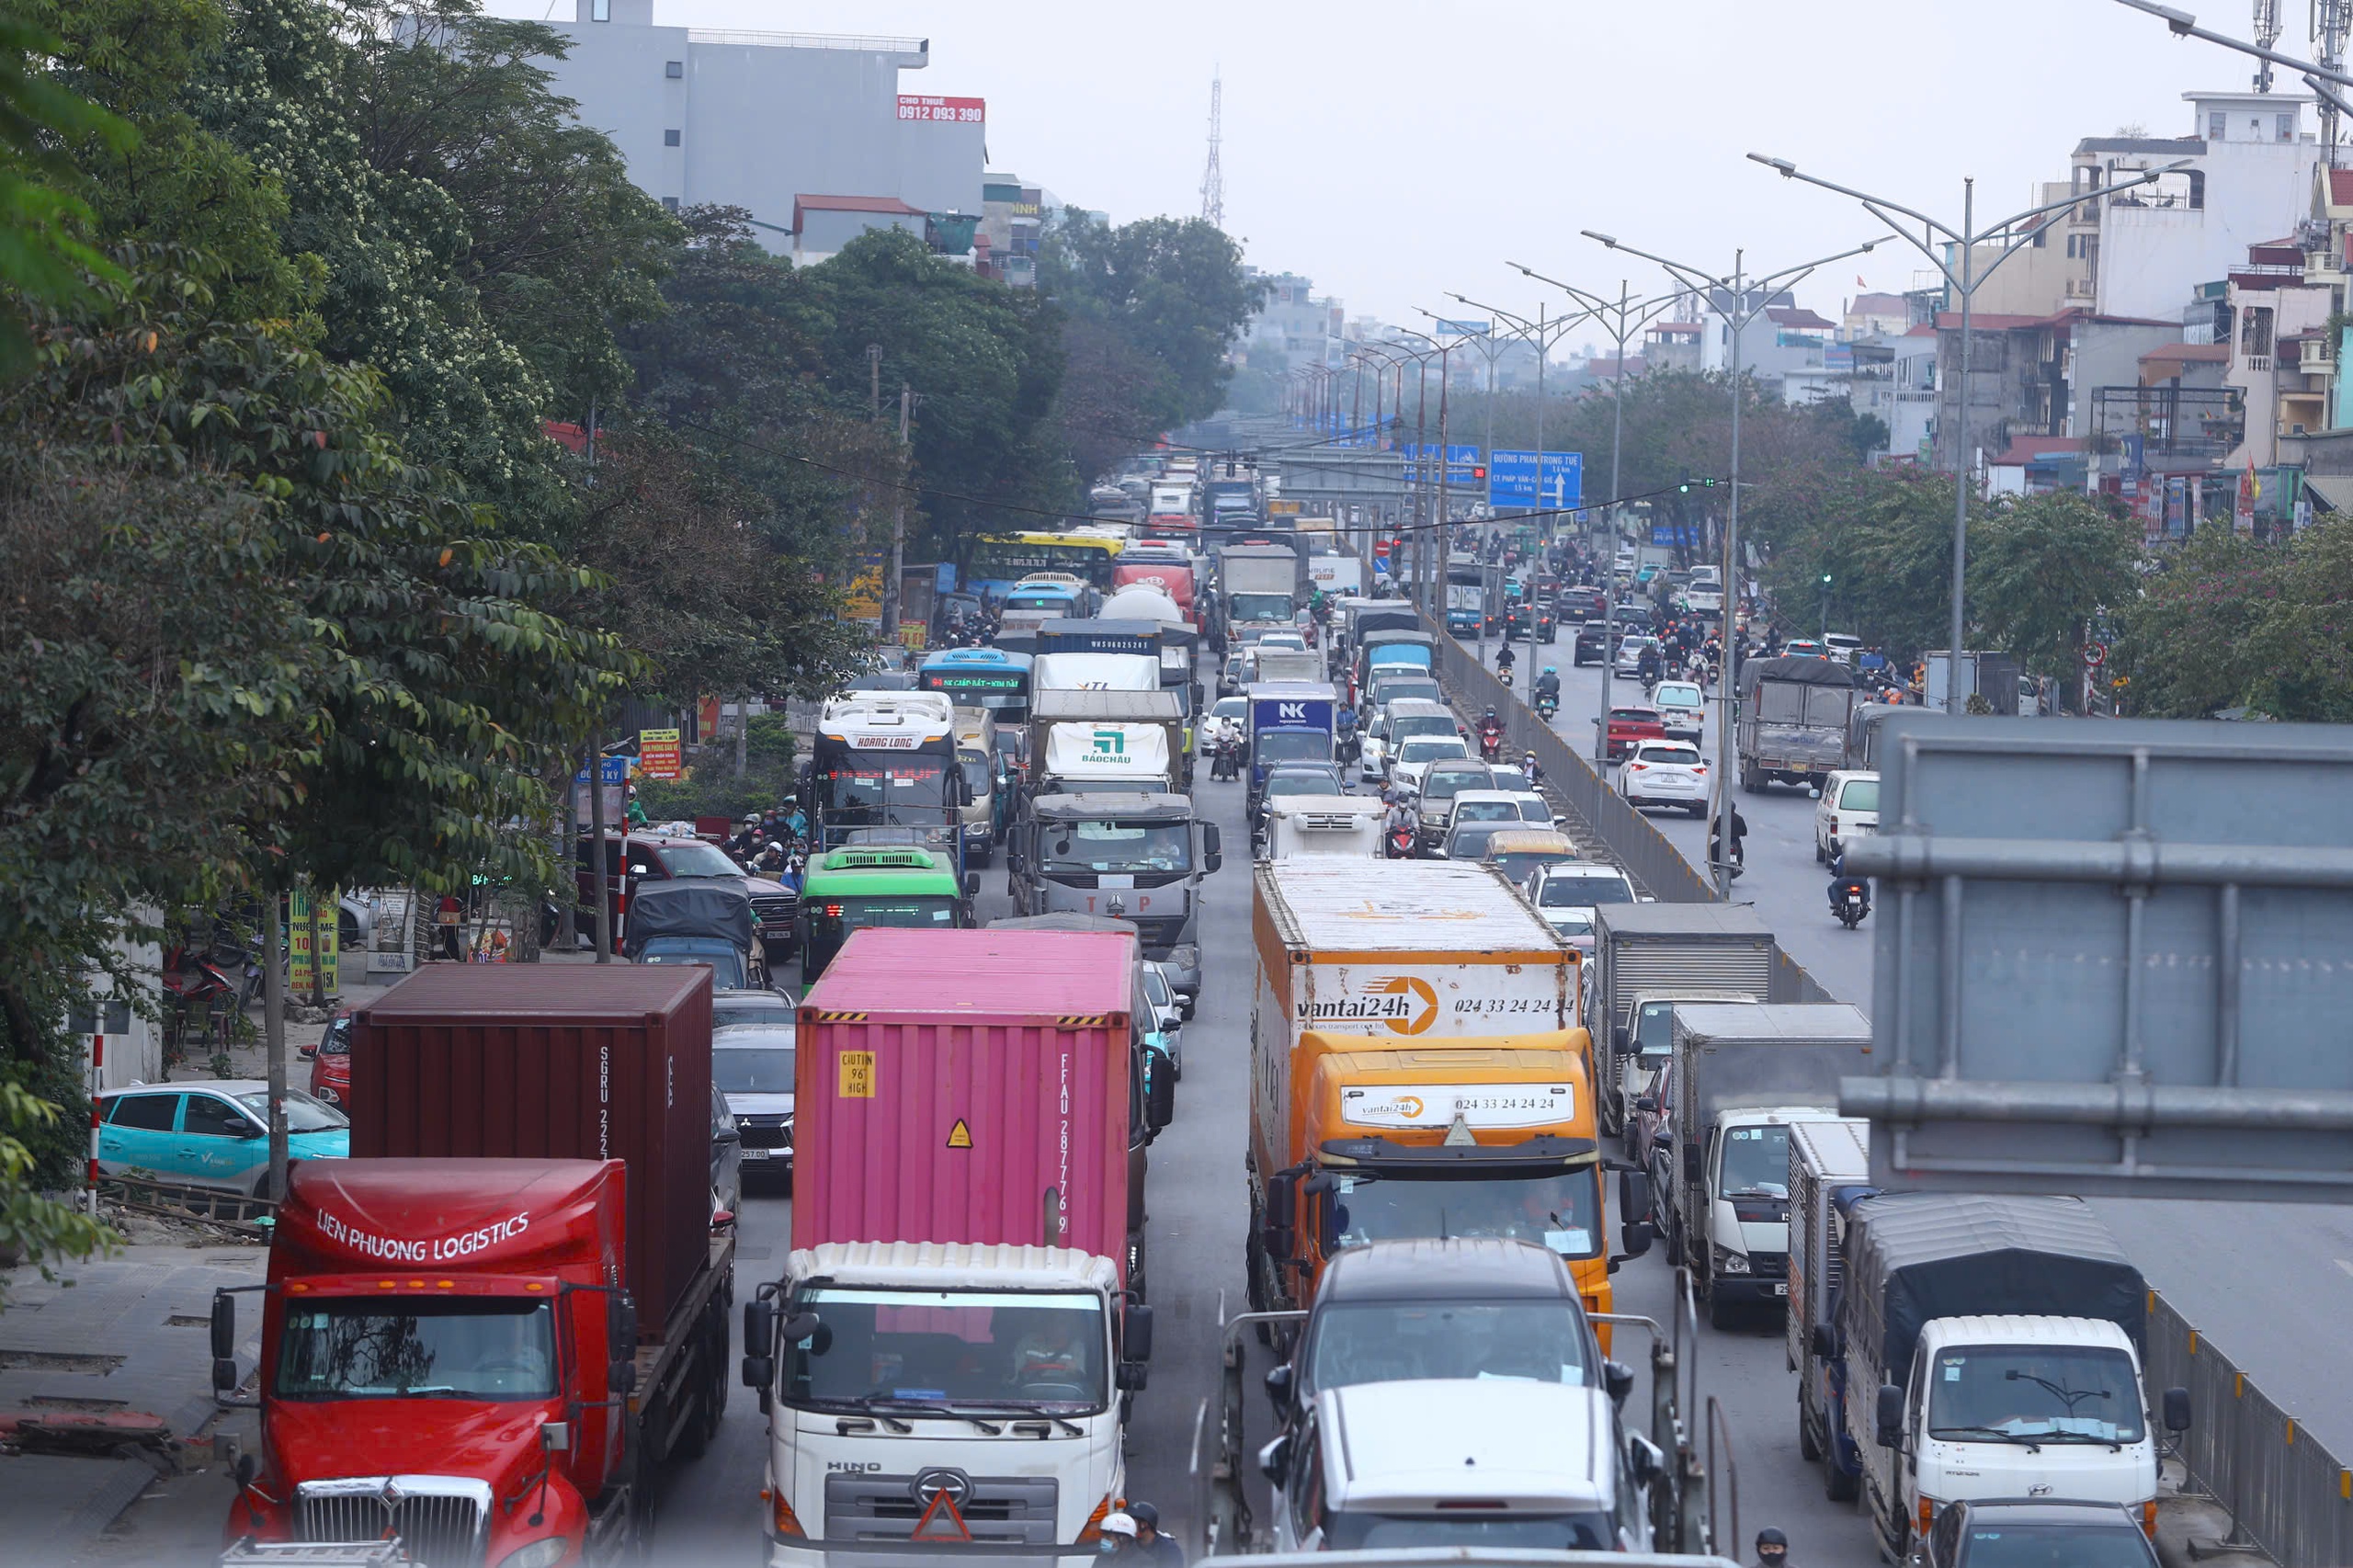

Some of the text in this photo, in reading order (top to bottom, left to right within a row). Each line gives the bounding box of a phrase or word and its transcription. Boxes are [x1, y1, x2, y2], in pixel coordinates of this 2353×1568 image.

[899, 106, 982, 121] 0912 093 390
[1279, 702, 1306, 719] NK
[857, 737, 913, 748] HOANG LONG
[1086, 897, 1151, 912] T P
[1297, 996, 1410, 1017] vantai24h
[1455, 999, 1482, 1013] 024
[1486, 999, 1505, 1013] 33
[1509, 999, 1528, 1013] 24
[1533, 999, 1551, 1013] 24
[600, 1046, 608, 1103] SGRU
[1362, 1103, 1412, 1114] vantai24h
[1456, 1098, 1554, 1109] 024 33 24 24 24
[1059, 1054, 1069, 1233] FFAU 287776 9
[317, 1208, 529, 1261] LIEN PHUONG LOGISTICS
[827, 1461, 881, 1471] HINO
